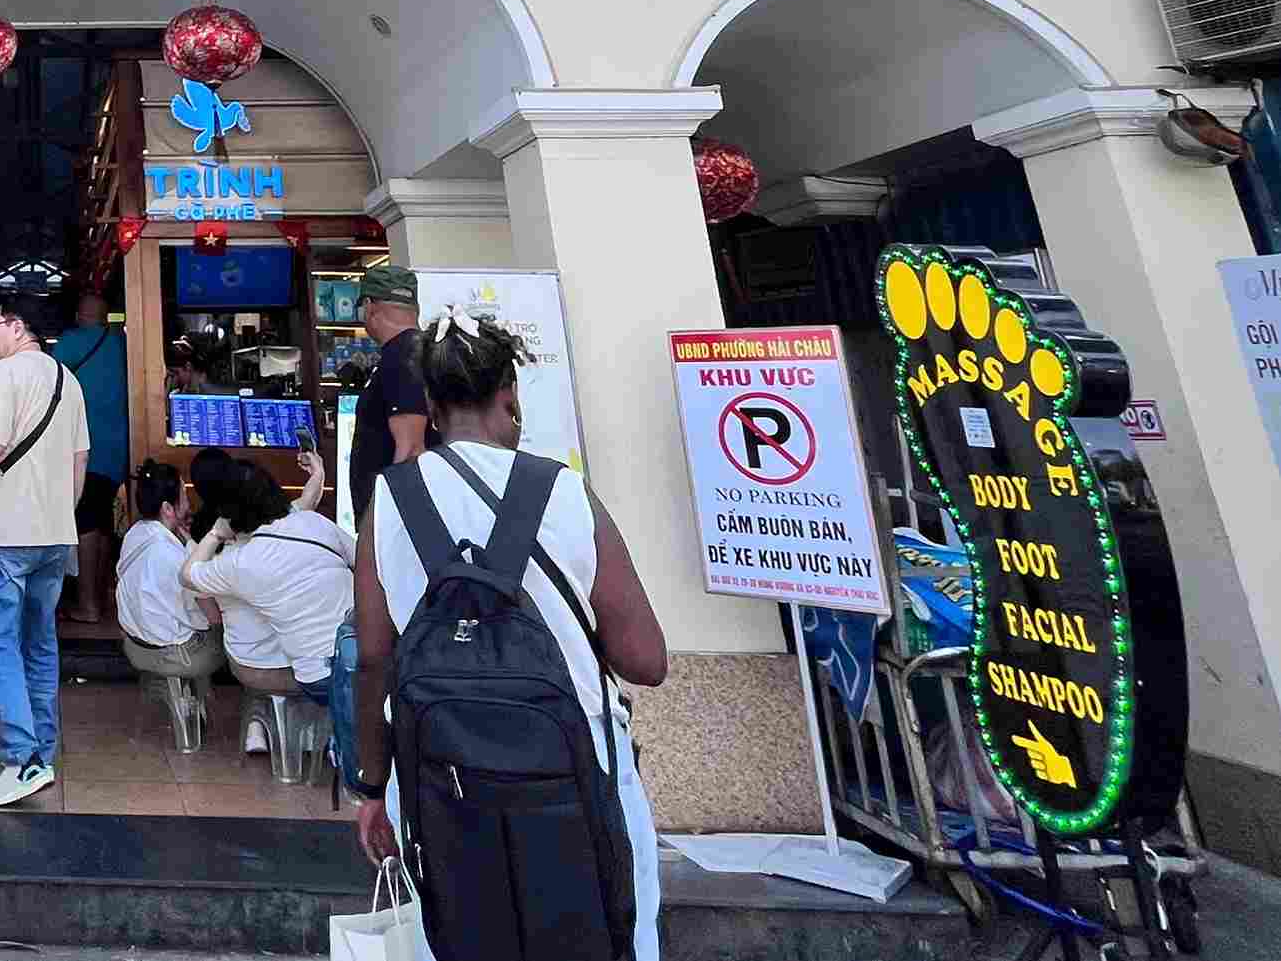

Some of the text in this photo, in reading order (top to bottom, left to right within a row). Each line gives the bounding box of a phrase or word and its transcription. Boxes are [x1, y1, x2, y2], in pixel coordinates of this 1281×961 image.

[676, 341, 709, 360] UBND
[699, 366, 816, 390] KHU VỰC
[907, 349, 1080, 497] MASSAGE
[715, 487, 842, 509] NO PARKING
[969, 474, 1032, 512] BODY
[757, 514, 806, 539] BUÔN
[733, 546, 755, 567] XE
[758, 548, 793, 571] KHU
[796, 551, 832, 578] VỰC
[995, 538, 1062, 581] FOOT
[1002, 601, 1097, 654] FACIAL
[987, 660, 1105, 725] SHAMPOO
